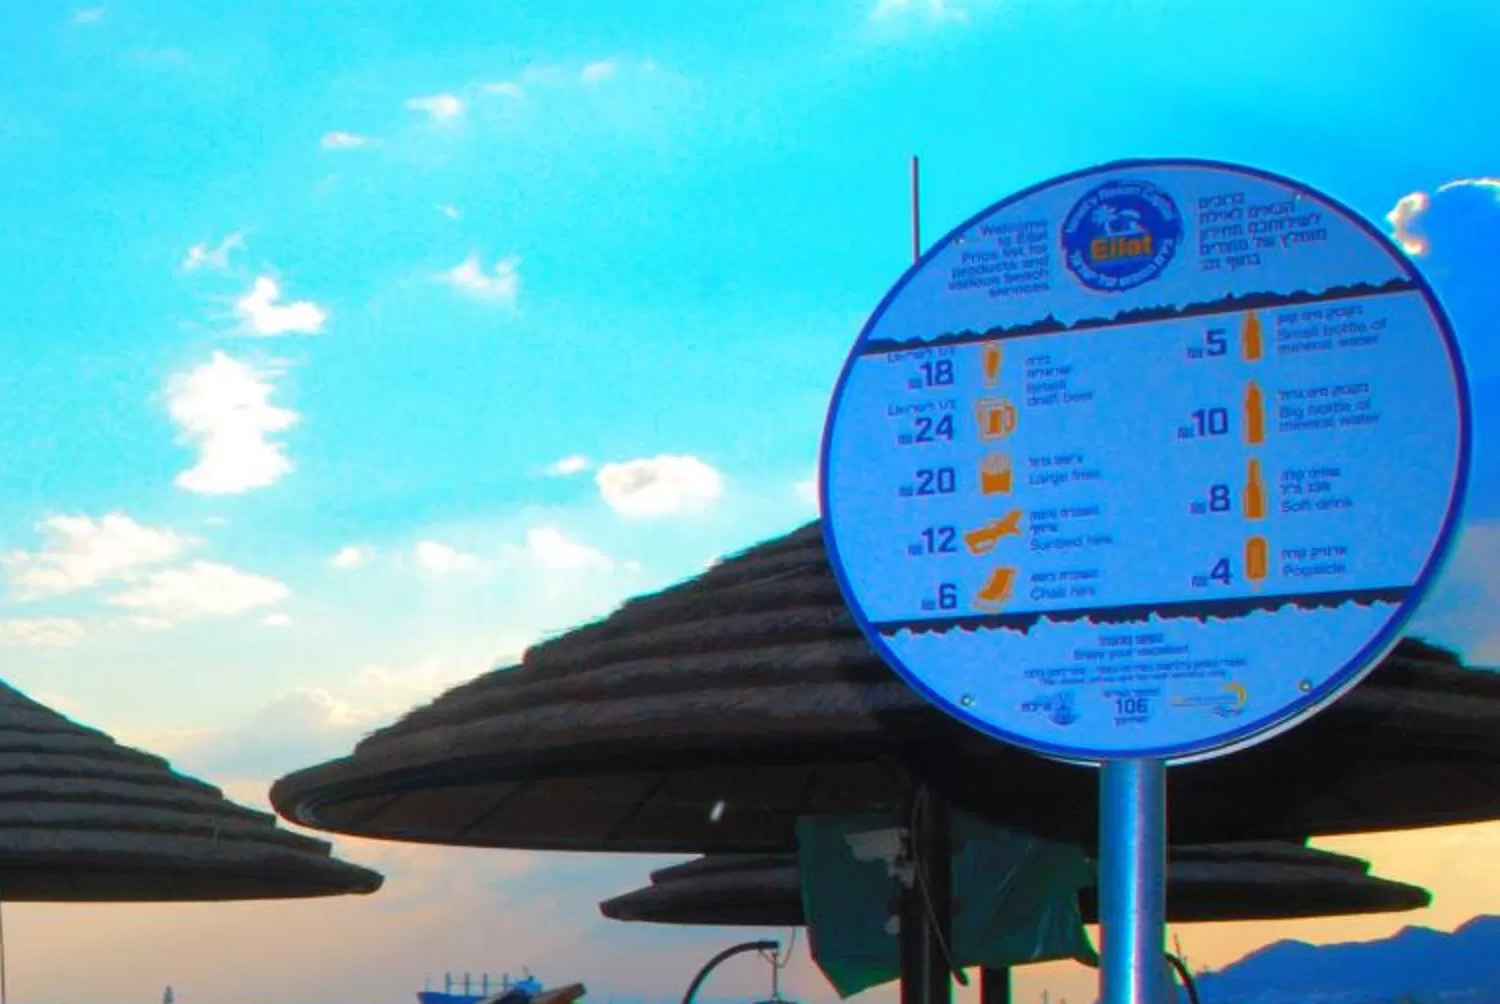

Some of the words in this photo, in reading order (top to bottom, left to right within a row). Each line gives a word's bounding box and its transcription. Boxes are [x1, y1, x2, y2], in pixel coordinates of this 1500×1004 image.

[1090, 236, 1154, 261] Eilat
[1207, 328, 1227, 356] 5
[920, 360, 954, 387] 18
[915, 415, 954, 443] 24
[1192, 408, 1228, 436] 10
[916, 468, 956, 495] 20
[1209, 484, 1230, 512] 8
[1281, 499, 1312, 513] Soft
[1315, 496, 1354, 511] drink
[922, 526, 957, 555] 12
[1210, 558, 1232, 585] 4
[939, 584, 957, 609] 6
[1114, 697, 1149, 715] 106
